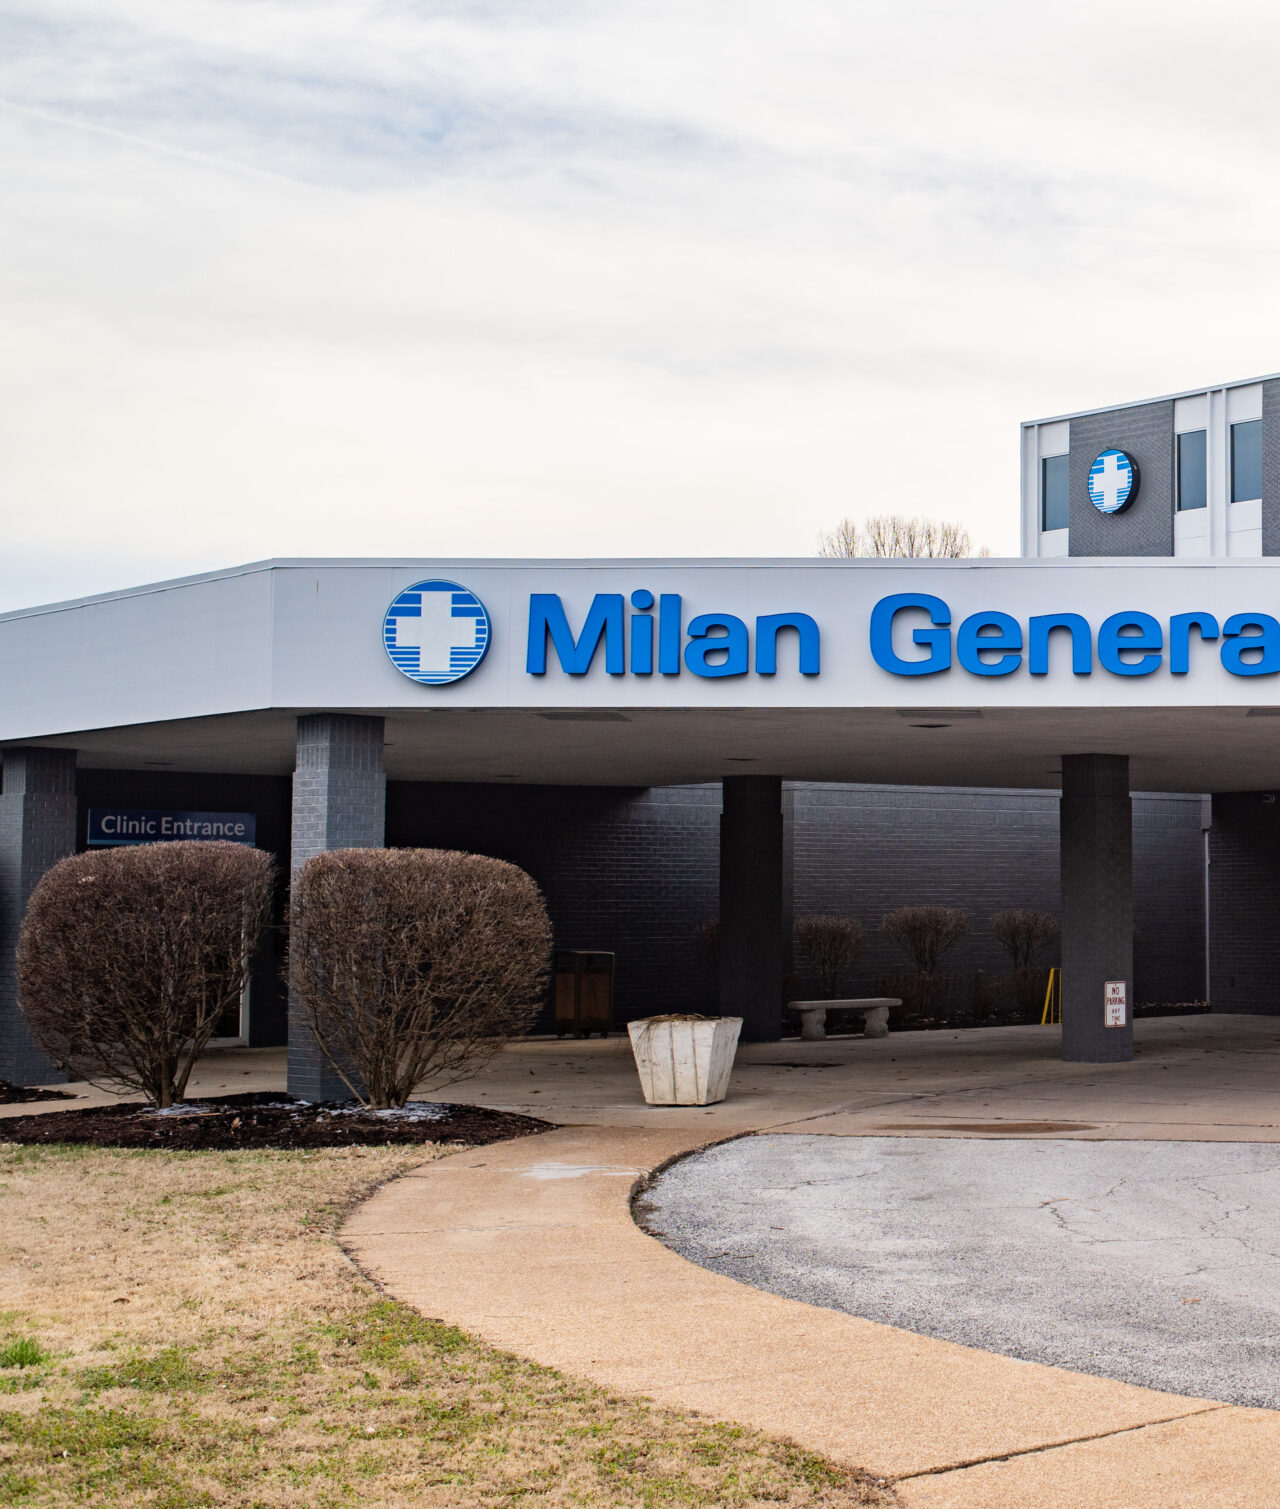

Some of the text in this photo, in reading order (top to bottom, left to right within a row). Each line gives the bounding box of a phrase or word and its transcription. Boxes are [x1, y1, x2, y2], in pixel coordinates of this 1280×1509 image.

[526, 589, 820, 678] Milan
[101, 815, 245, 836] Clinic Entrance
[1112, 987, 1120, 995] NO
[1106, 997, 1126, 1005] PARKING
